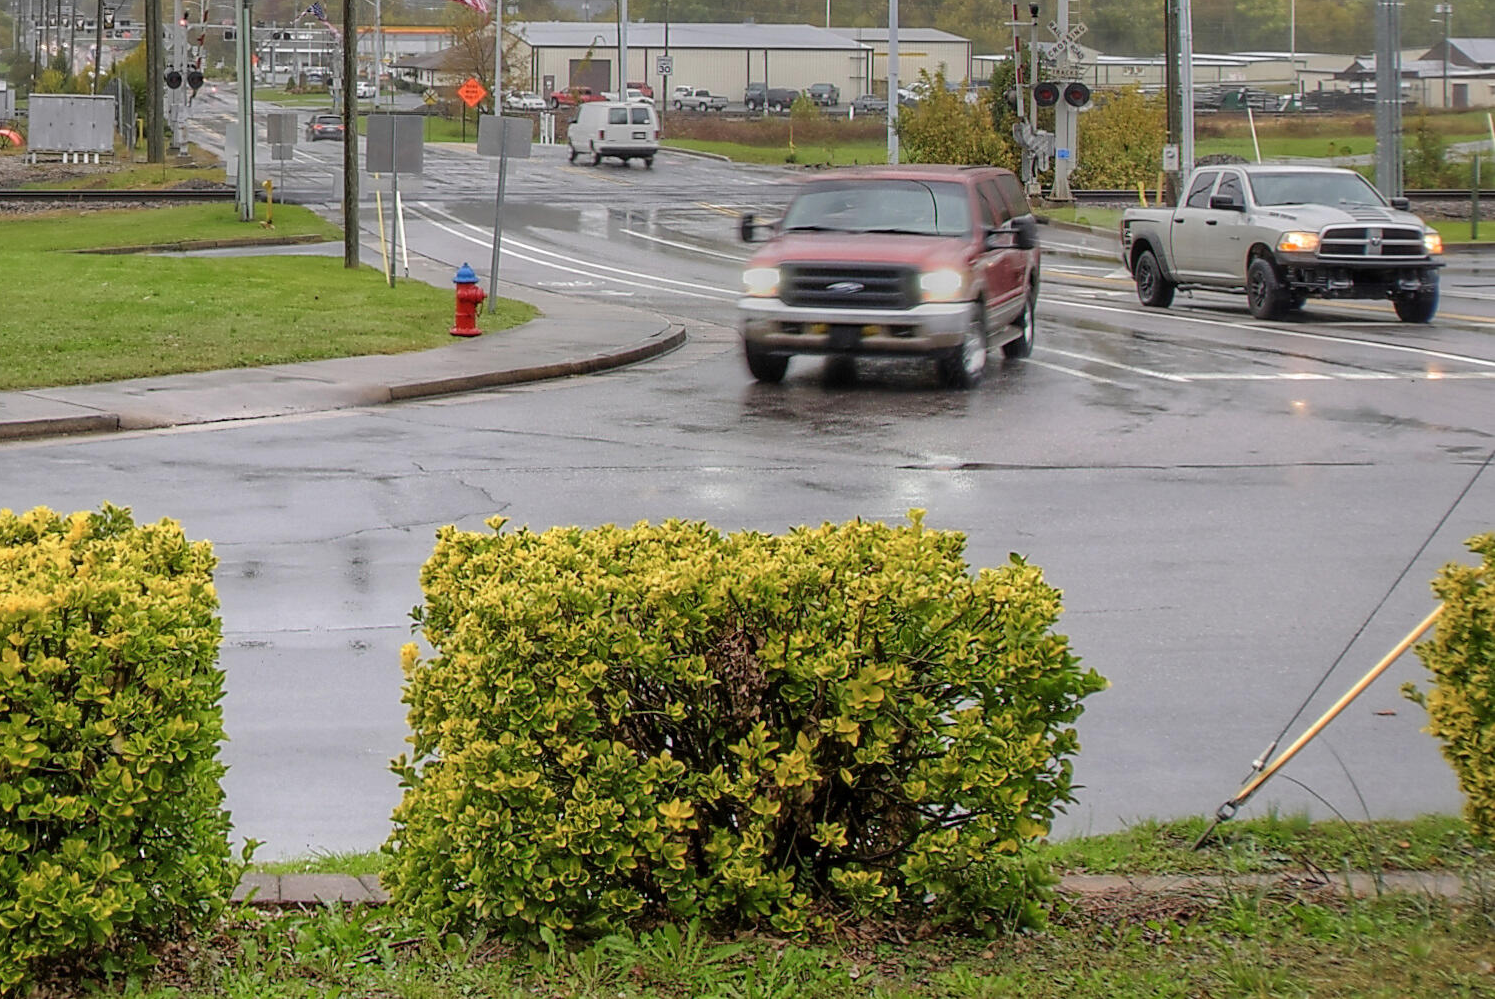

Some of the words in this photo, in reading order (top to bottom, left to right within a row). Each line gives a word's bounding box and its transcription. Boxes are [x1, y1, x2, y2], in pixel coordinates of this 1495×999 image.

[1049, 22, 1062, 37] RAIL
[1048, 25, 1085, 57] CROSSING
[1070, 44, 1084, 59] ROAD
[659, 65, 671, 73] 30
